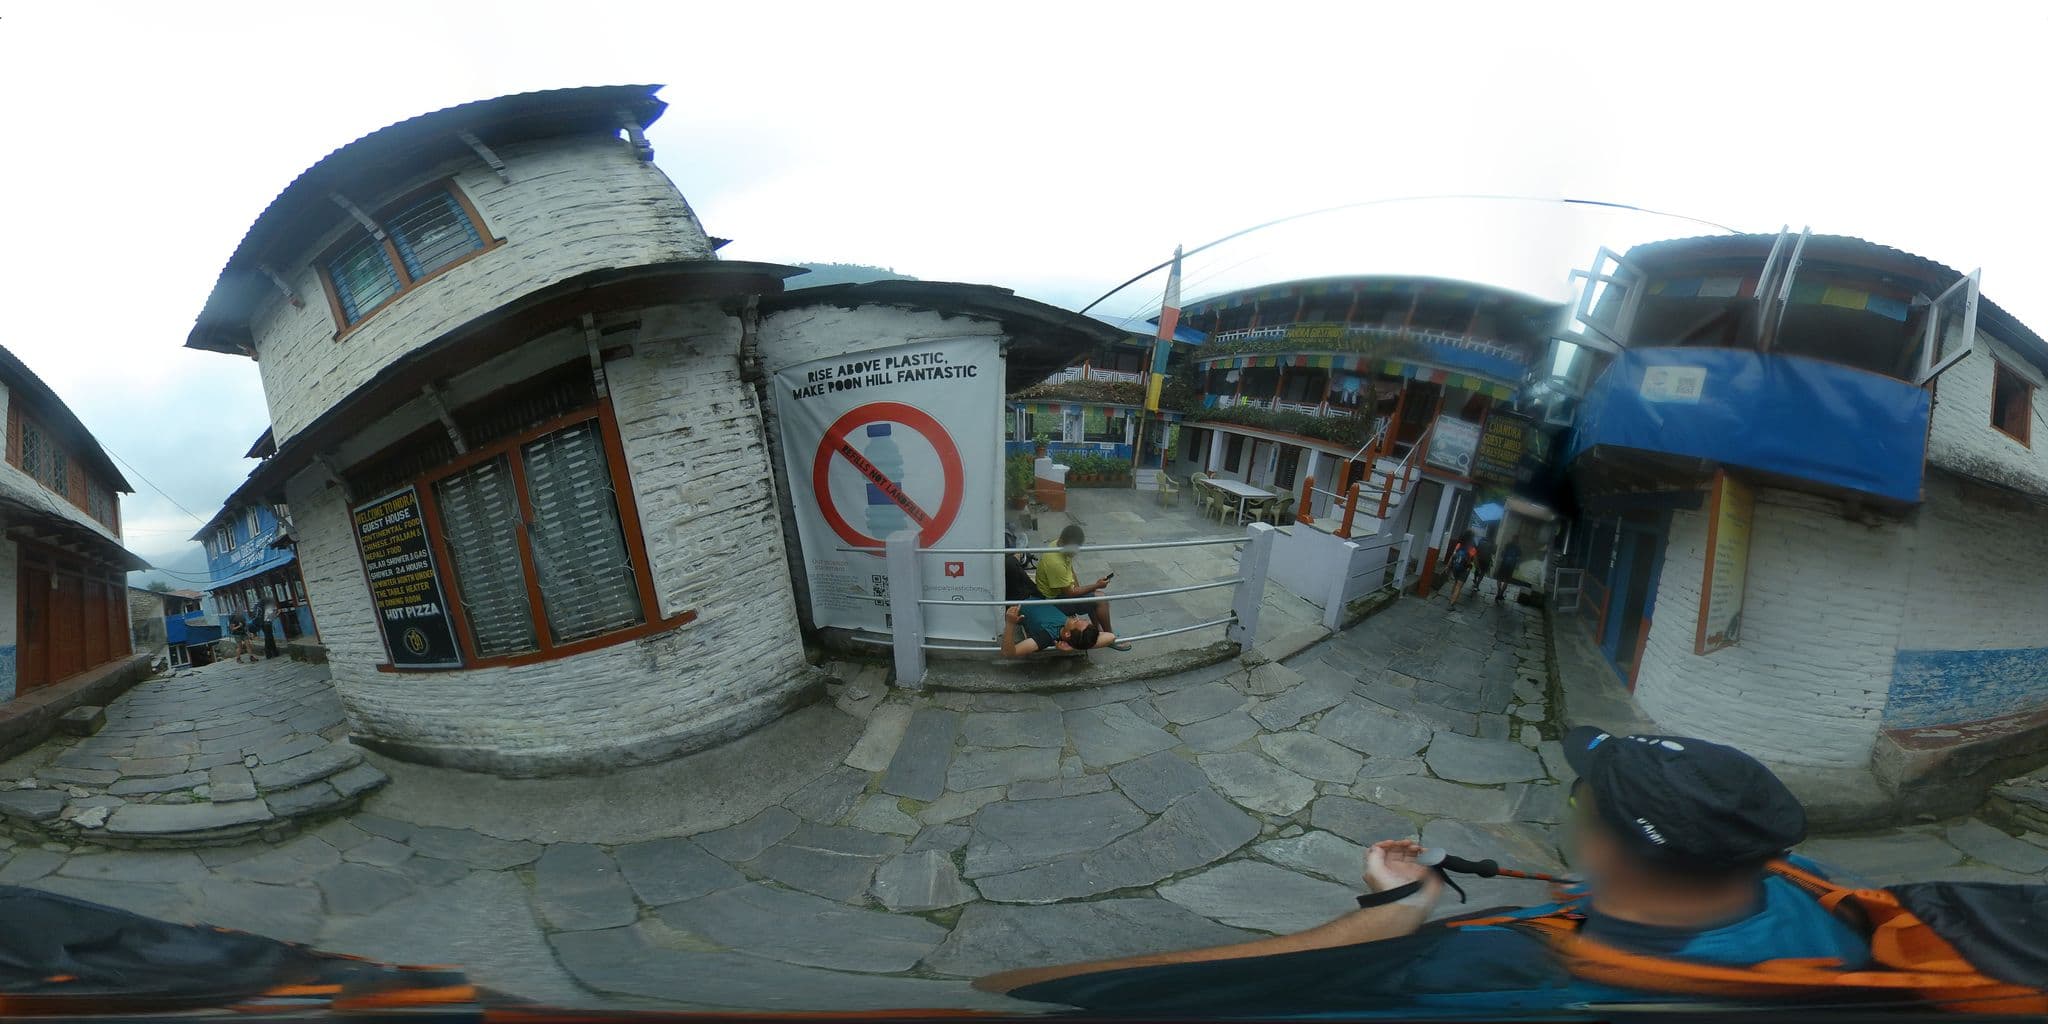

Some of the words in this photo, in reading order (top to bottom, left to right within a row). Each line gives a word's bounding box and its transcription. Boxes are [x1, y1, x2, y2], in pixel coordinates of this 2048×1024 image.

[807, 367, 833, 384] RISE
[837, 359, 881, 378] ABOVE
[885, 351, 948, 370] PLASTIC,
[792, 379, 825, 400] MAKE
[828, 376, 862, 393] POON
[866, 371, 893, 387] HILL
[897, 364, 977, 383] FANTASTIC
[842, 445, 871, 472] REFILLS
[869, 469, 887, 488] NOT
[886, 483, 926, 523] LANDFILLS
[356, 506, 385, 525] WELCOME
[384, 502, 394, 514] TO
[362, 518, 384, 534] GUEST
[385, 508, 411, 525] HOUSE
[361, 524, 403, 543] CONTINENTAL
[404, 517, 421, 529] FOOD
[387, 545, 402, 556] FOOD
[414, 549, 428, 560] GAS
[370, 568, 394, 580] SHOWER
[395, 566, 406, 575] 24
[406, 560, 429, 572] HOURS
[405, 581, 430, 594] HEATER
[385, 607, 404, 621] HOT
[405, 602, 441, 619] PIZZA
